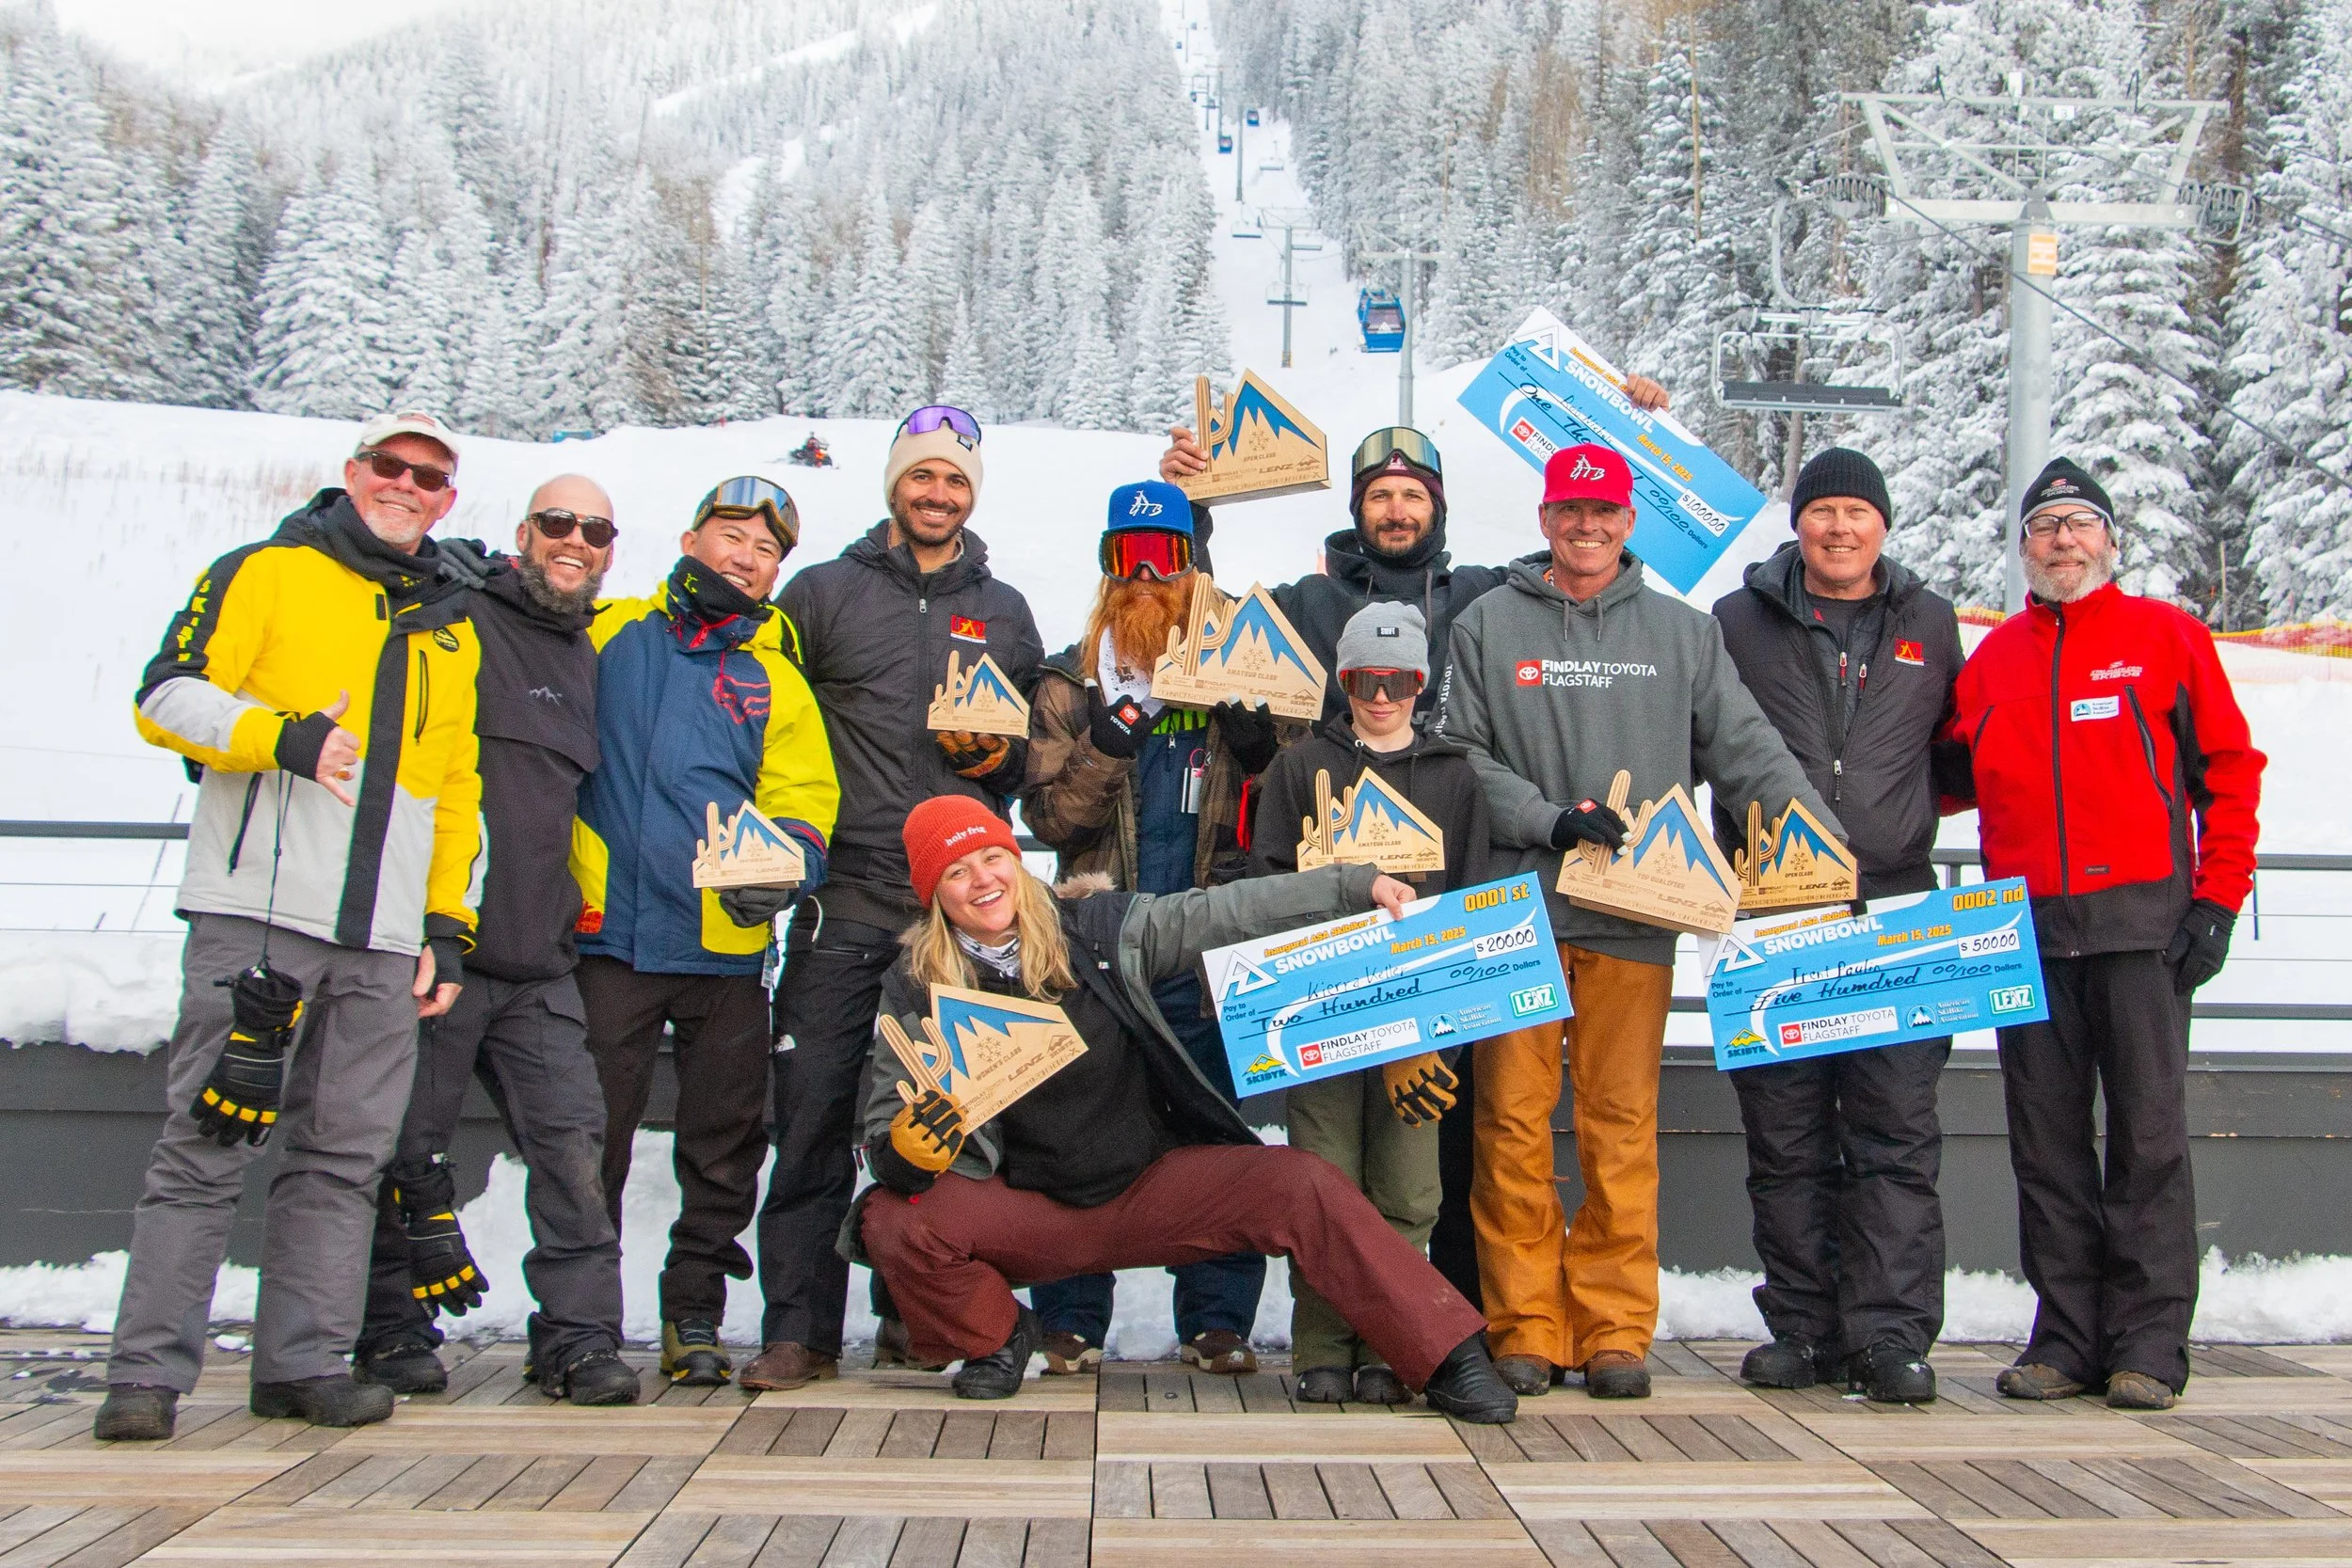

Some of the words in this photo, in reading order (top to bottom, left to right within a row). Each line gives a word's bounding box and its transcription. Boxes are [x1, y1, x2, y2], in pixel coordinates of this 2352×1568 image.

[1505, 352, 1520, 366] Order
[1510, 345, 1520, 356] Pay
[1519, 382, 1551, 411] One
[1564, 360, 1654, 434] SNOWBOWL
[1526, 440, 1552, 463] FLAGS
[1533, 432, 1558, 454] FINDL
[1244, 454, 1258, 463] OPEN
[1259, 451, 1277, 461] CLASS
[1637, 433, 1662, 457] March
[1671, 462, 1693, 483] 2025
[1259, 463, 1294, 474] LENZ
[1649, 489, 1690, 530] 00/100
[1687, 530, 1708, 549] Dollars
[1227, 669, 1257, 680] AMATEUR
[1258, 673, 1279, 682] CLASS
[1541, 659, 1601, 674] FINDLAY
[1602, 662, 1657, 677] TOYOTA
[2091, 671, 2140, 681] SKIBOB
[1440, 664, 1454, 704] TOYOTA
[1542, 673, 1613, 689] FLAGSTAFF
[1248, 688, 1288, 699] LENZ
[1110, 716, 1131, 735] TOYOTA
[945, 830, 967, 847] holy
[1464, 886, 1507, 912] 0001
[1511, 881, 1531, 901] st
[1657, 894, 1699, 909] LENZ
[1952, 889, 1996, 911] 0002
[2002, 884, 2026, 904] nd
[1755, 921, 1799, 939] Inaugural
[1800, 915, 1820, 929] ASA
[1820, 909, 1853, 924] Skibike
[1264, 936, 1309, 958] Inaugural
[1309, 930, 1329, 943] ASA
[1330, 920, 1370, 937] Skibiker
[1370, 915, 1378, 925] X
[1391, 939, 1422, 955] March
[1423, 933, 1439, 946] 15,
[1440, 926, 1467, 942] 2025
[1486, 928, 1534, 953] 200.00
[1764, 916, 1883, 956] SNOWBOWL
[1877, 931, 1908, 946] March
[1911, 928, 1925, 942] 15,
[1927, 925, 1952, 939] 2025
[1275, 926, 1396, 974] SNOWBOWL
[1791, 965, 1829, 985] Trent
[1836, 958, 1881, 979] Paulin
[1307, 976, 1359, 1002] Kierra
[1365, 964, 1409, 985] Keller
[1711, 981, 1724, 990] Pay
[1712, 989, 1734, 998] Order
[1750, 990, 1802, 1011] Five
[1932, 963, 1992, 978] 00/100
[1994, 962, 2022, 973] Dollars
[1250, 1015, 1303, 1032] Two
[1320, 977, 1422, 1016] Hundred
[1450, 962, 1510, 980] 00/100
[1513, 958, 1541, 972] Dollars
[1515, 988, 1554, 1013] LENZ
[1937, 998, 1970, 1009] American
[1993, 988, 2031, 1011] LENZ
[1224, 1004, 1237, 1013] Pay
[1225, 1010, 1247, 1022] Order
[1248, 1008, 1257, 1017] of
[1458, 1004, 1491, 1016] American
[1940, 1011, 1979, 1023] Association
[1461, 1016, 1502, 1031] Association
[1802, 1016, 1848, 1032] FINDLAY
[1851, 1008, 1895, 1024] TOYOTA
[1321, 1032, 1368, 1052] FINDLAY
[1371, 1020, 1416, 1038] TOYOTA
[1803, 1024, 1861, 1042] FLAGSTAFF
[1323, 1039, 1382, 1063] FLAGSTAFF
[1727, 1044, 1767, 1058] SKIBYK
[975, 1059, 1004, 1082] WOMEN'S
[1004, 1046, 1023, 1063] CLASS
[1008, 1052, 1044, 1082] LENZ
[1245, 1068, 1288, 1085] SKIBYK
